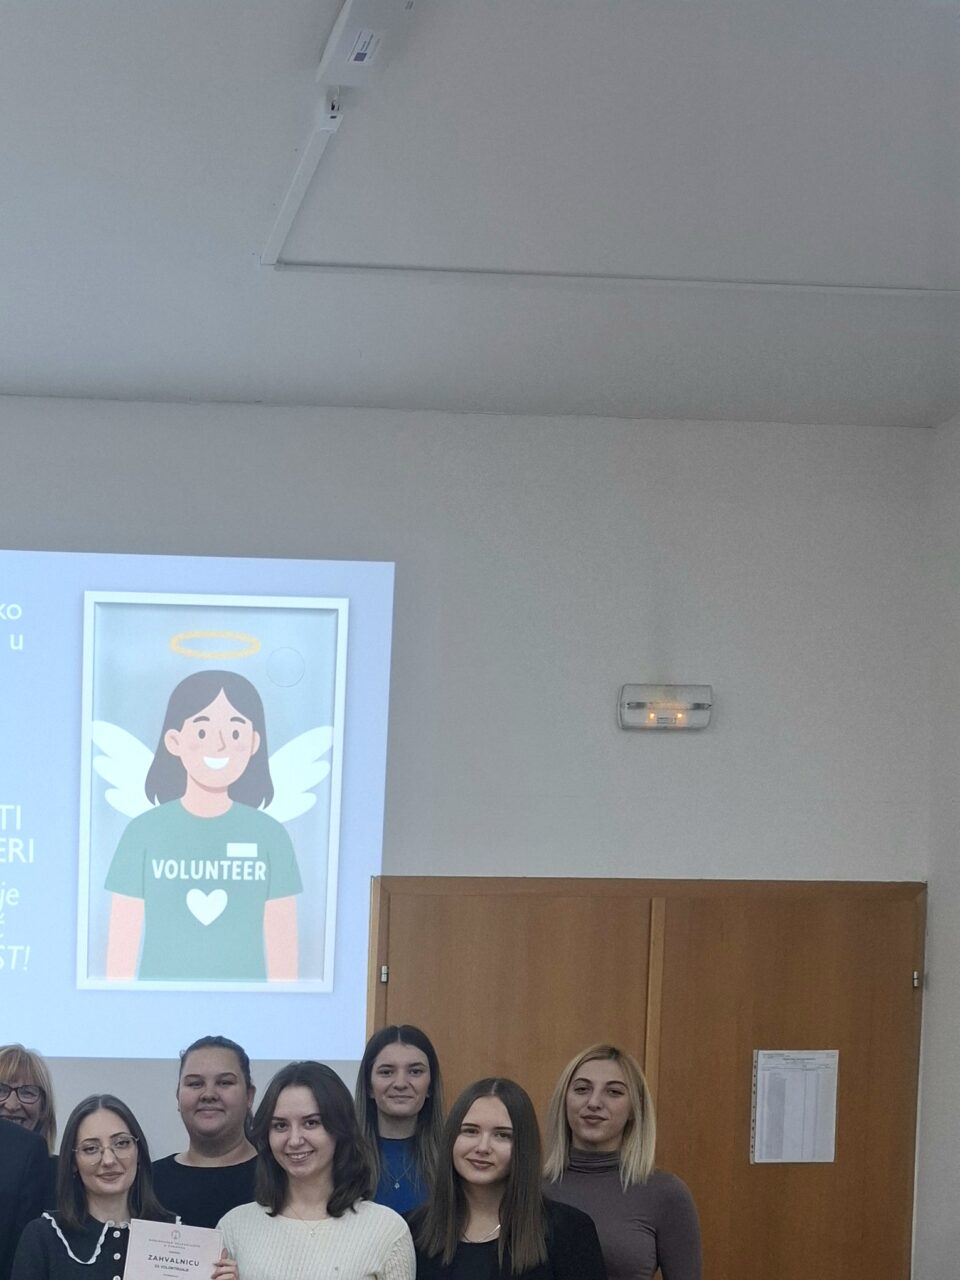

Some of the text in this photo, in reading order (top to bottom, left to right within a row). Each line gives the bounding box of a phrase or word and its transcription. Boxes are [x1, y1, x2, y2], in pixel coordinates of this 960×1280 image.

[9, 633, 24, 650] u
[151, 858, 266, 881] VOLUNTEER
[147, 1254, 200, 1267] ZAHVALNICU
